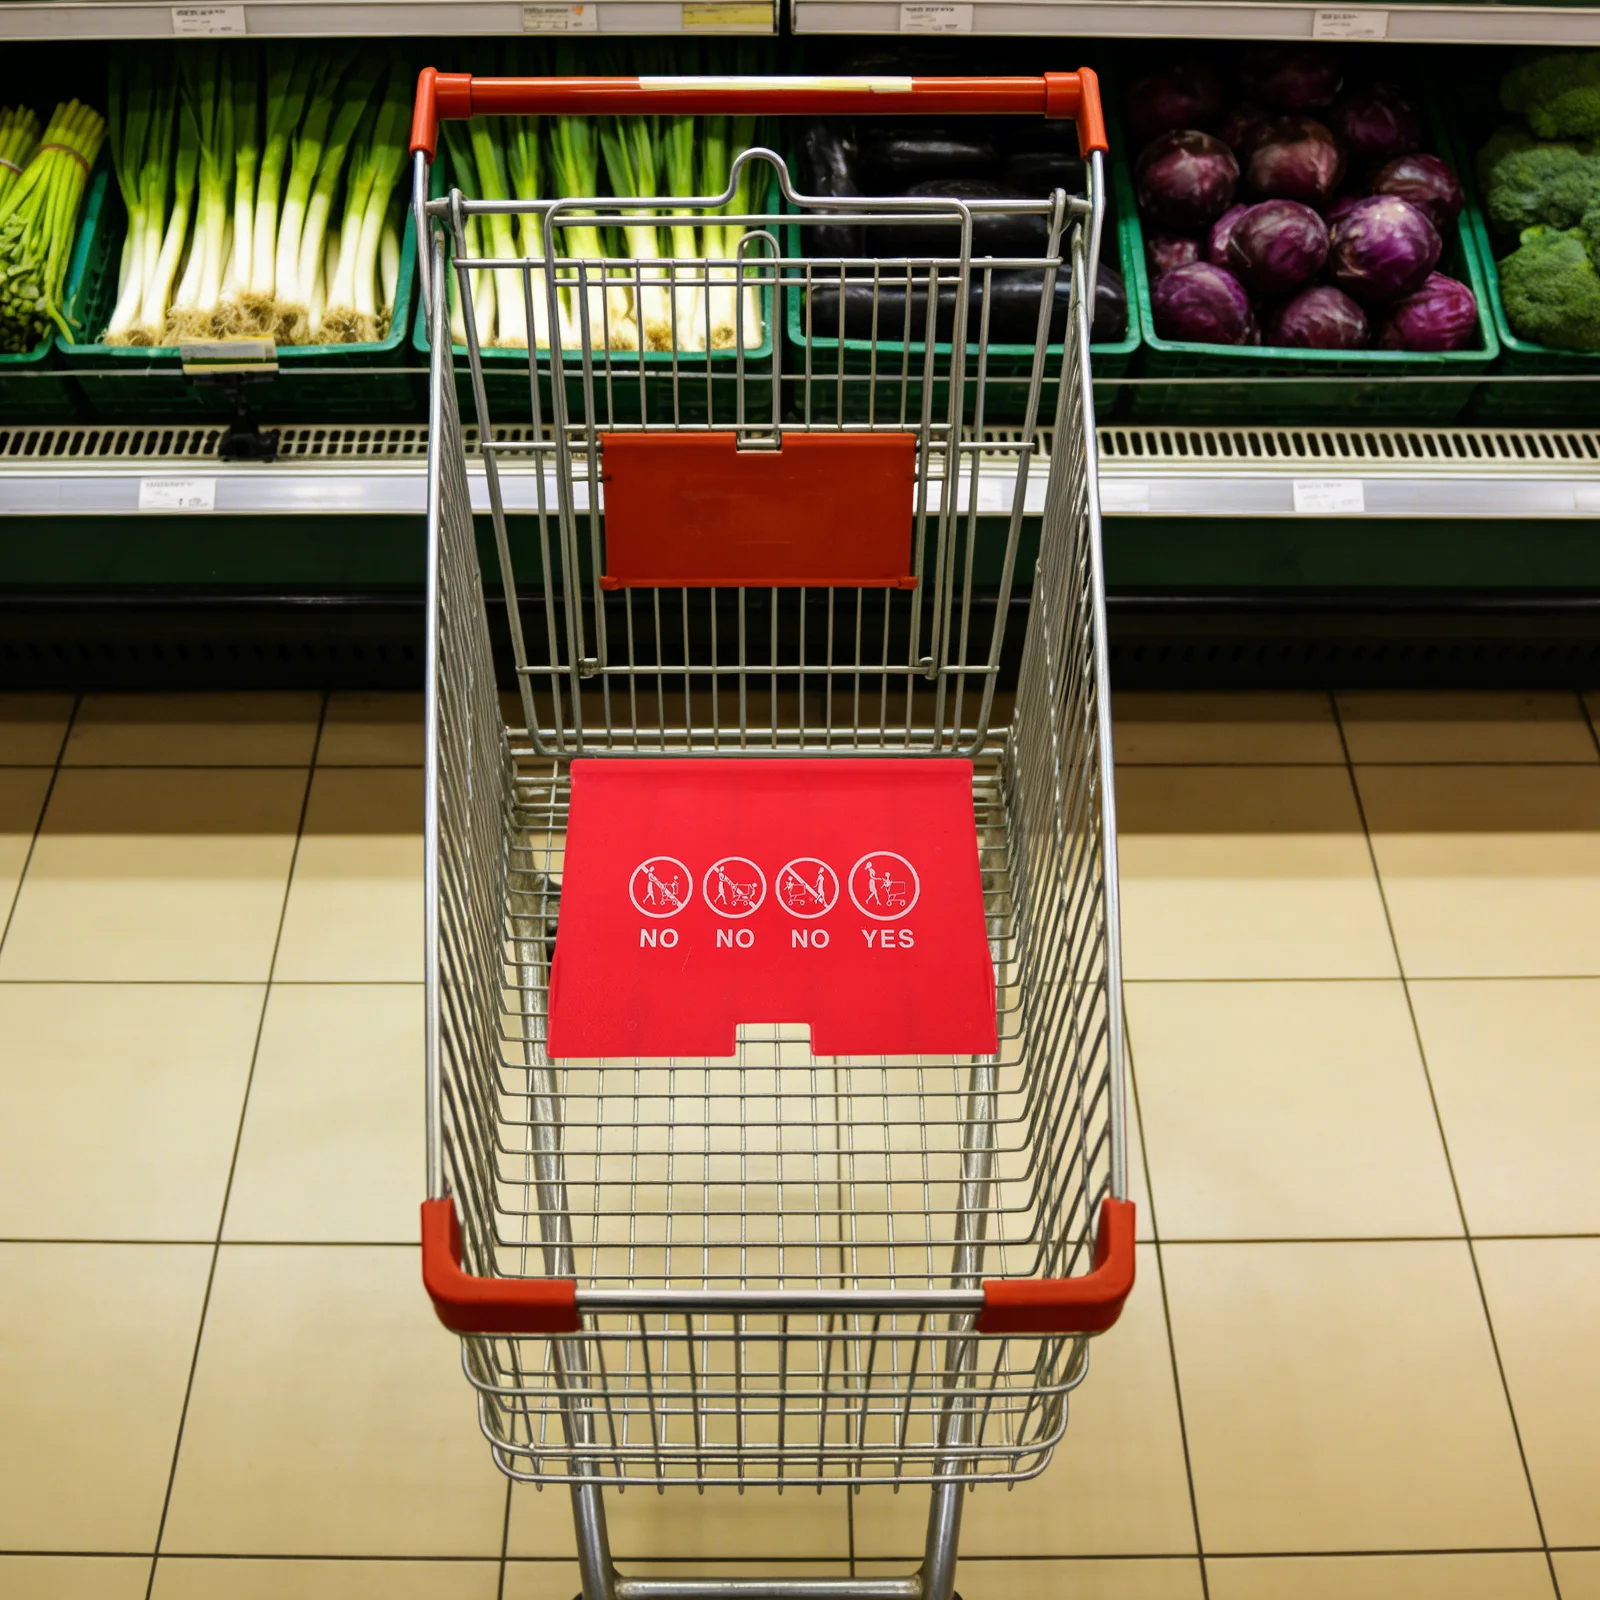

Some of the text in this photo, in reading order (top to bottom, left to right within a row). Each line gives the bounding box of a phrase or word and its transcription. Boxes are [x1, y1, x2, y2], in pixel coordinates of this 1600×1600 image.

[639, 928, 915, 949] NO NO NO YES
